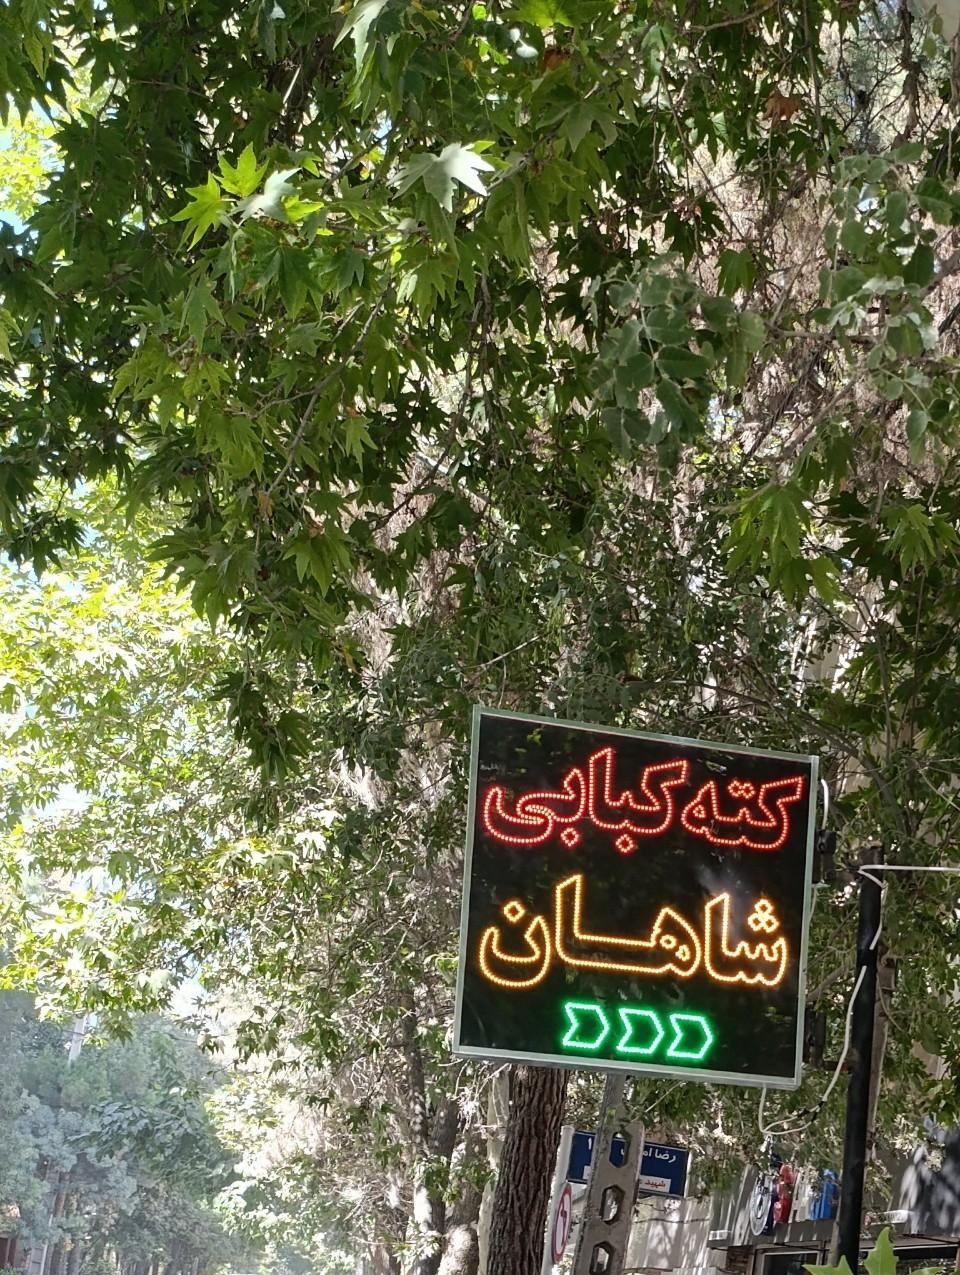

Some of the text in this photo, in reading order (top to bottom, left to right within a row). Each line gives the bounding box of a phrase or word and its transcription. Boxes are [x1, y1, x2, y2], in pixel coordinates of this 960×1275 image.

[483, 747, 804, 854] کته کبابی
[478, 873, 789, 988] شاهان
[654, 1148, 677, 1164] رضا
